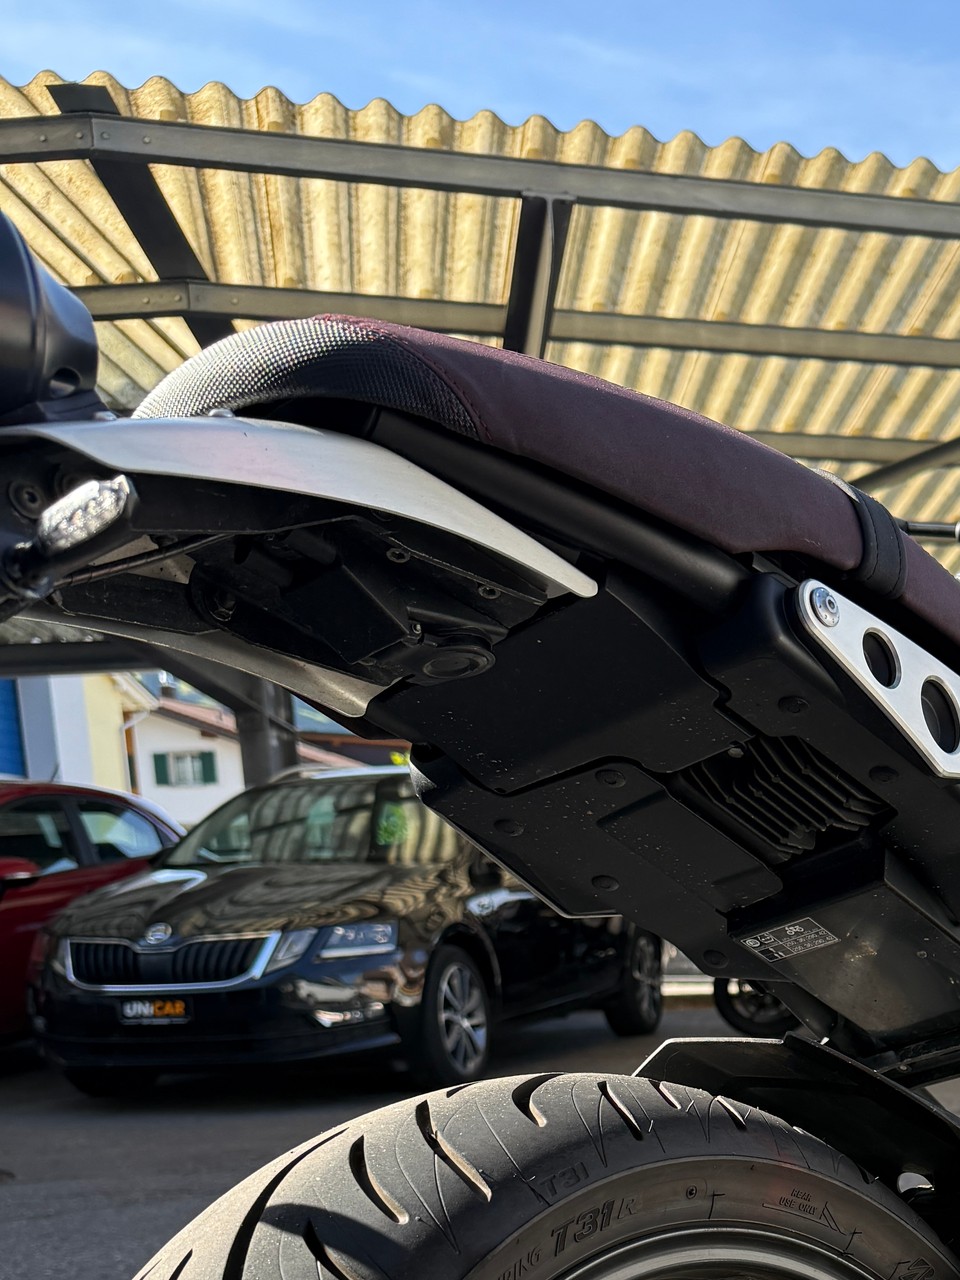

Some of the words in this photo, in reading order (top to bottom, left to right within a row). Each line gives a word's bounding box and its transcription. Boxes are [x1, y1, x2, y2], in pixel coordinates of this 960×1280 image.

[537, 1161, 590, 1198] T31
[778, 1196, 796, 1209] USE
[798, 1202, 818, 1216] ONLY
